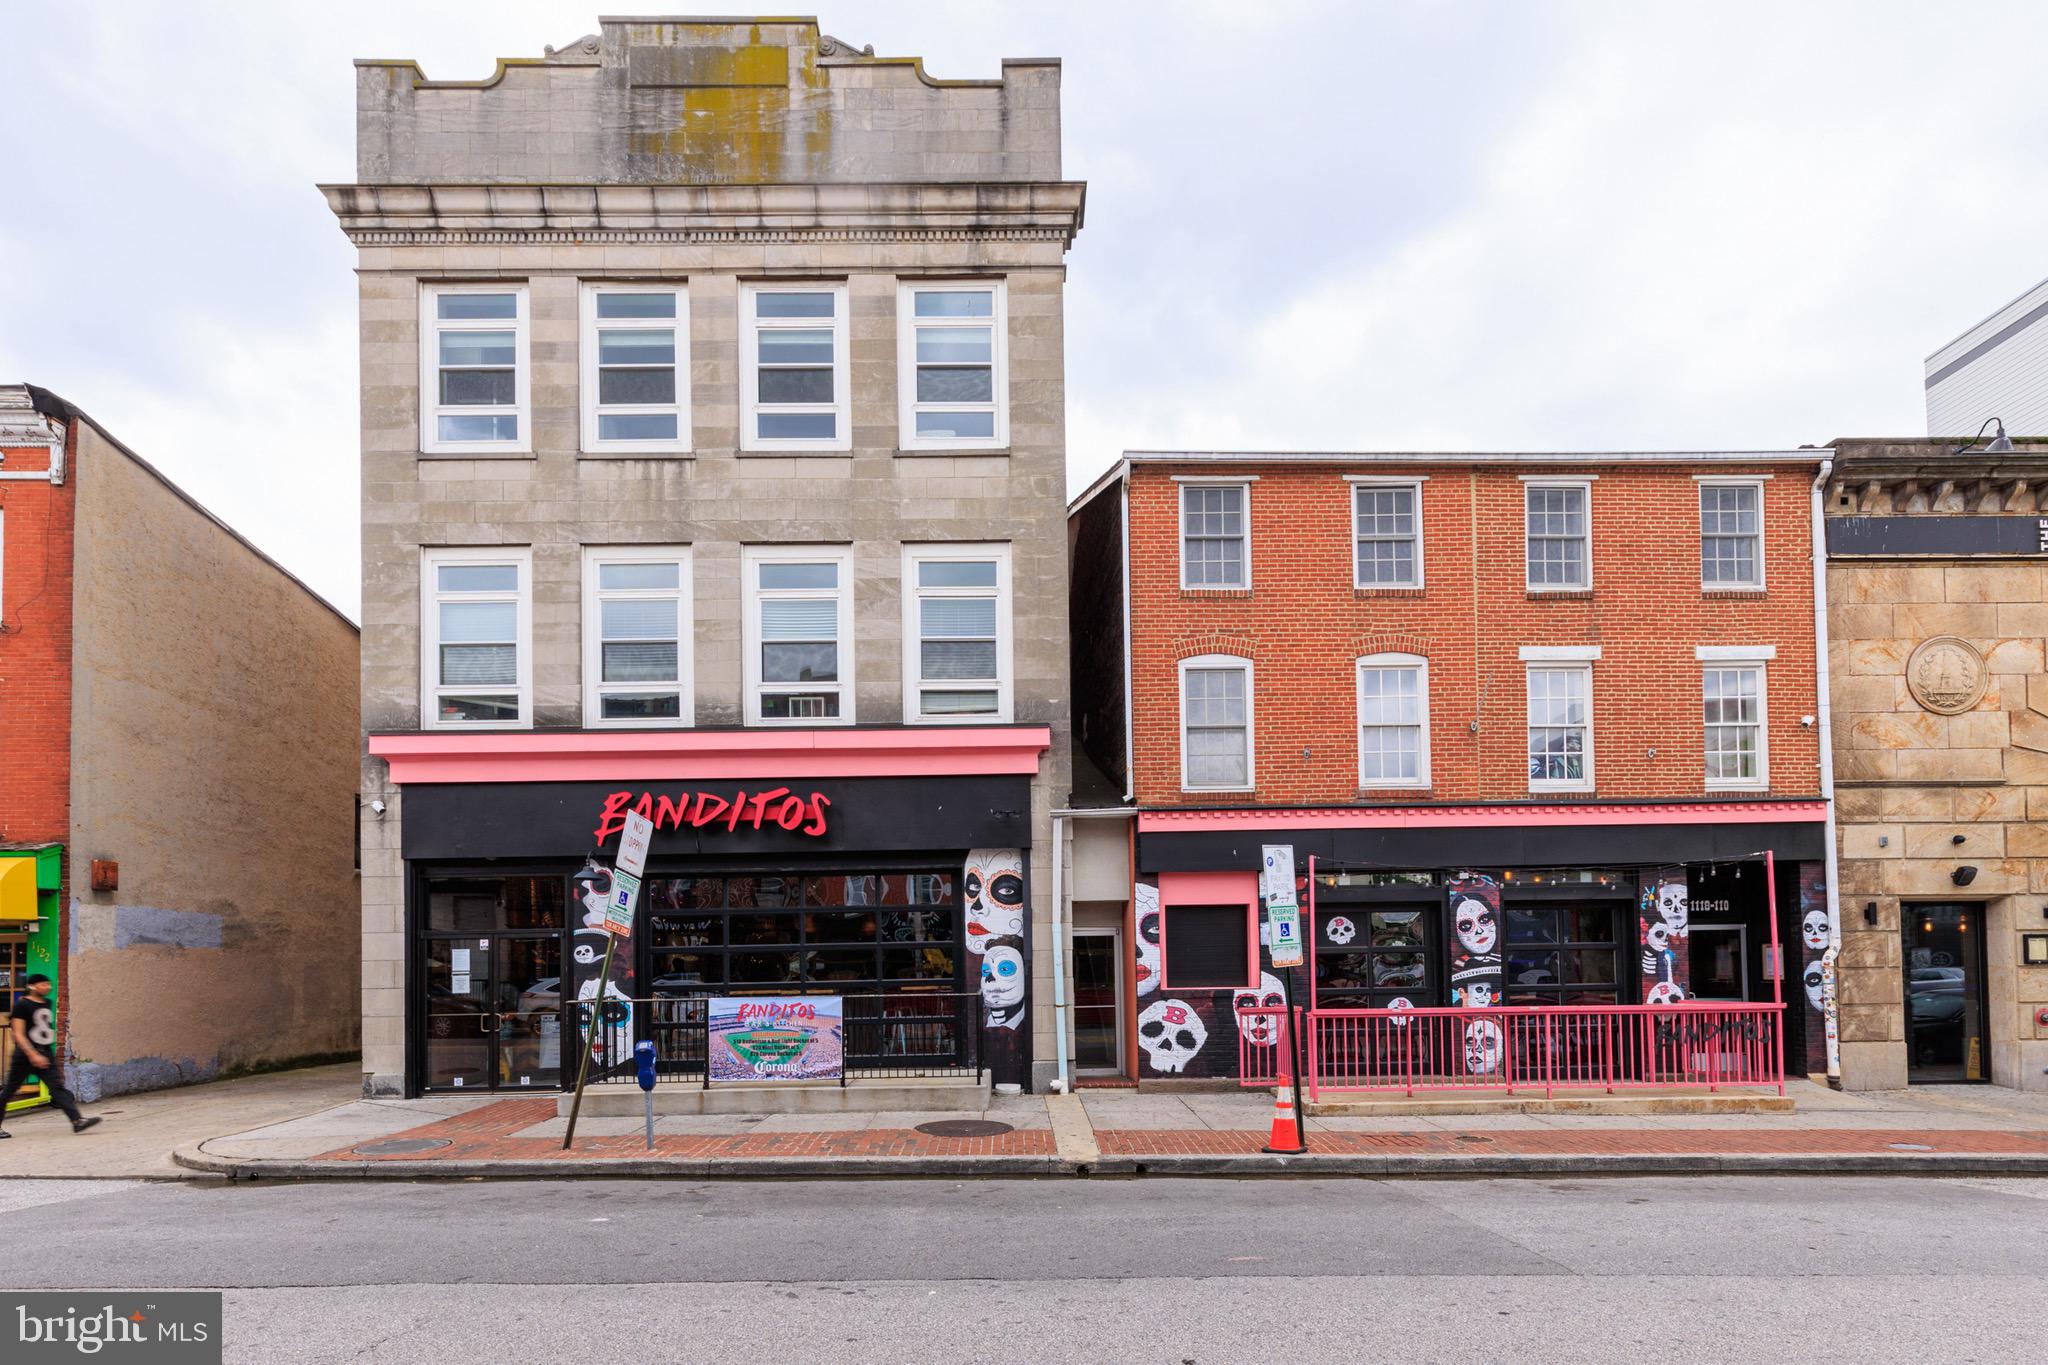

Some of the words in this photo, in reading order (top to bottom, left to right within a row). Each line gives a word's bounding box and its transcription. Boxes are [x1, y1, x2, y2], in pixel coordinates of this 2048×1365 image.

[594, 787, 831, 847] BANDITOS
[633, 821, 644, 834] NO
[616, 873, 638, 889] RESERVED
[617, 881, 635, 895] PARKING
[1690, 900, 1729, 911] 1118-110
[32, 941, 50, 962] 1122
[737, 1002, 815, 1022] BANDITOS
[1162, 1006, 1188, 1025] B
[29, 1007, 55, 1046] 8
[1655, 1018, 1771, 1049] BANDITOS
[754, 1060, 798, 1074] Corona
